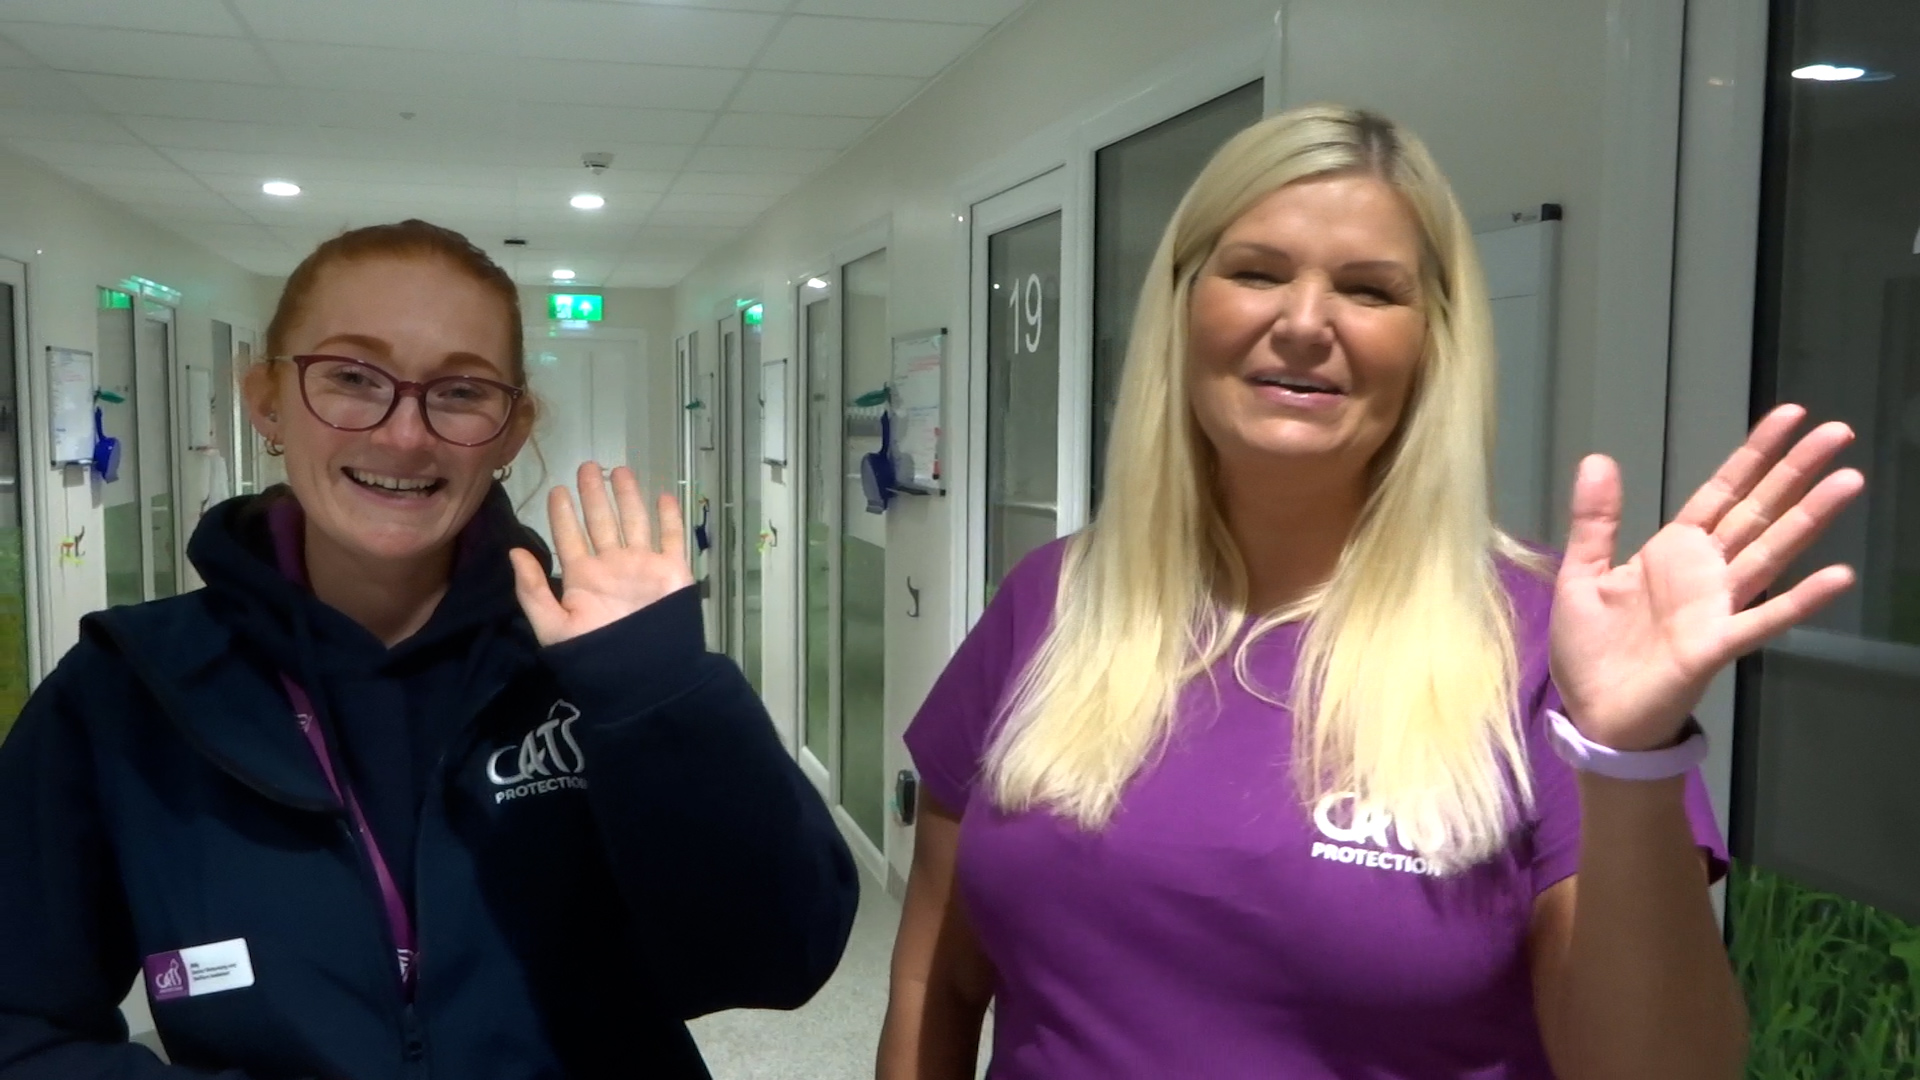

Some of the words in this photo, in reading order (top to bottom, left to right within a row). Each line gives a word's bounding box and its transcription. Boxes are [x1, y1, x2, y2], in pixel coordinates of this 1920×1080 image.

[1008, 273, 1042, 354] 19
[486, 699, 585, 785] CATS
[1311, 842, 1441, 876] PROTECTION
